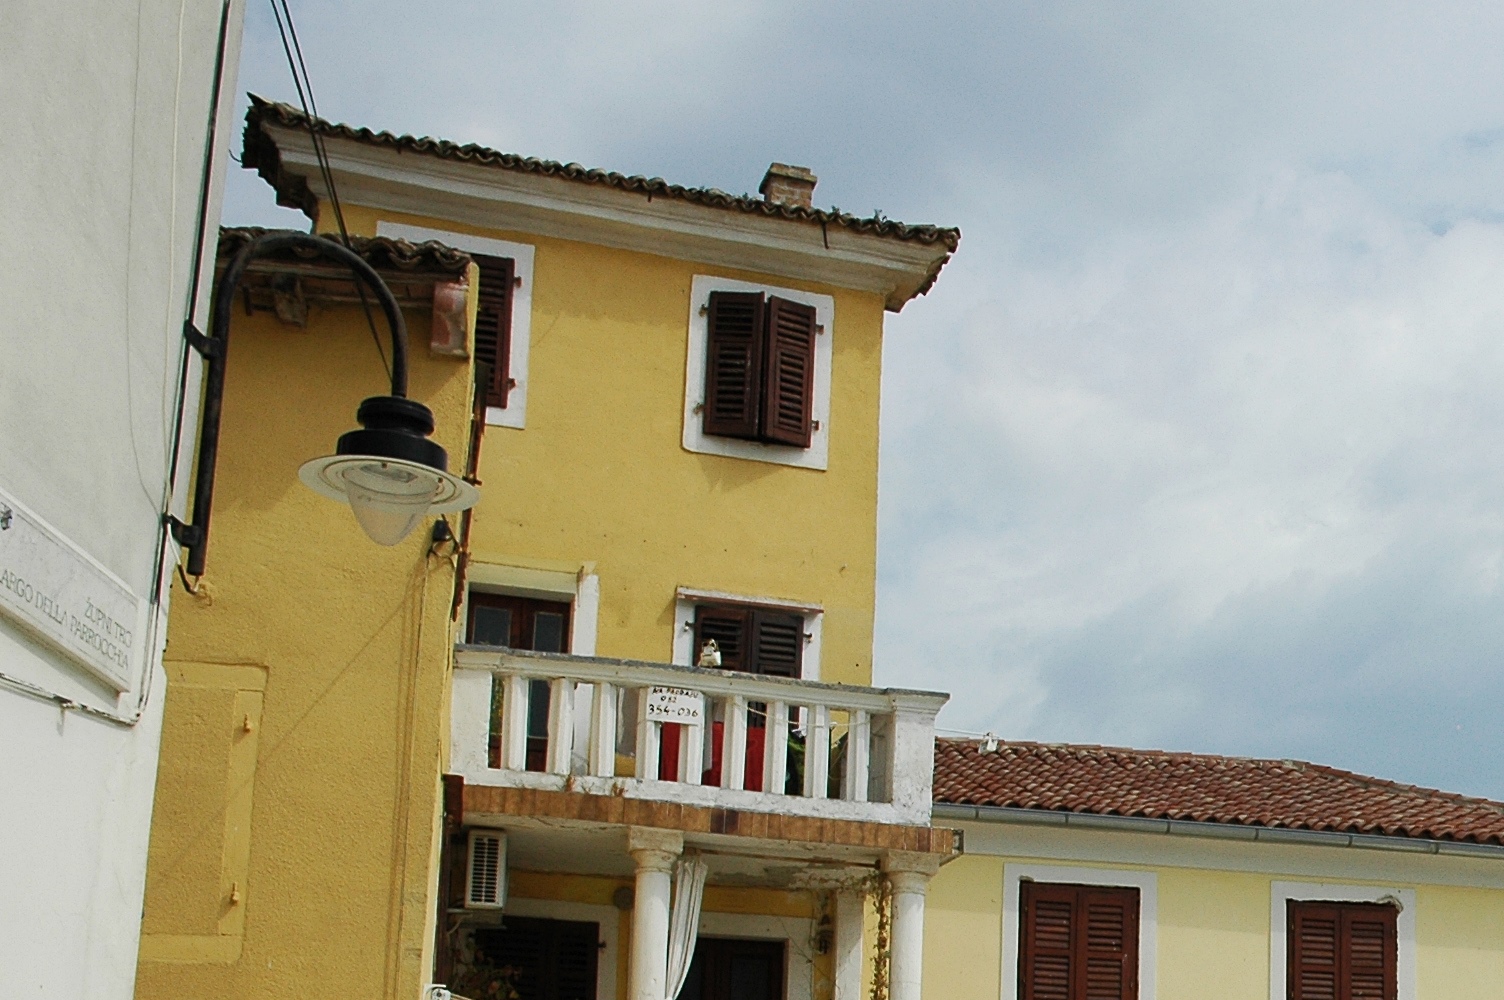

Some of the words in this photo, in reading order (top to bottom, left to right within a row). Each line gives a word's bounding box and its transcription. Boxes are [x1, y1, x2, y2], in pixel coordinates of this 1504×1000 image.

[0, 569, 34, 603] ARGO
[35, 591, 68, 627] DELLA
[70, 615, 129, 670] PARROCCHIA
[648, 703, 699, 718] 354-036
